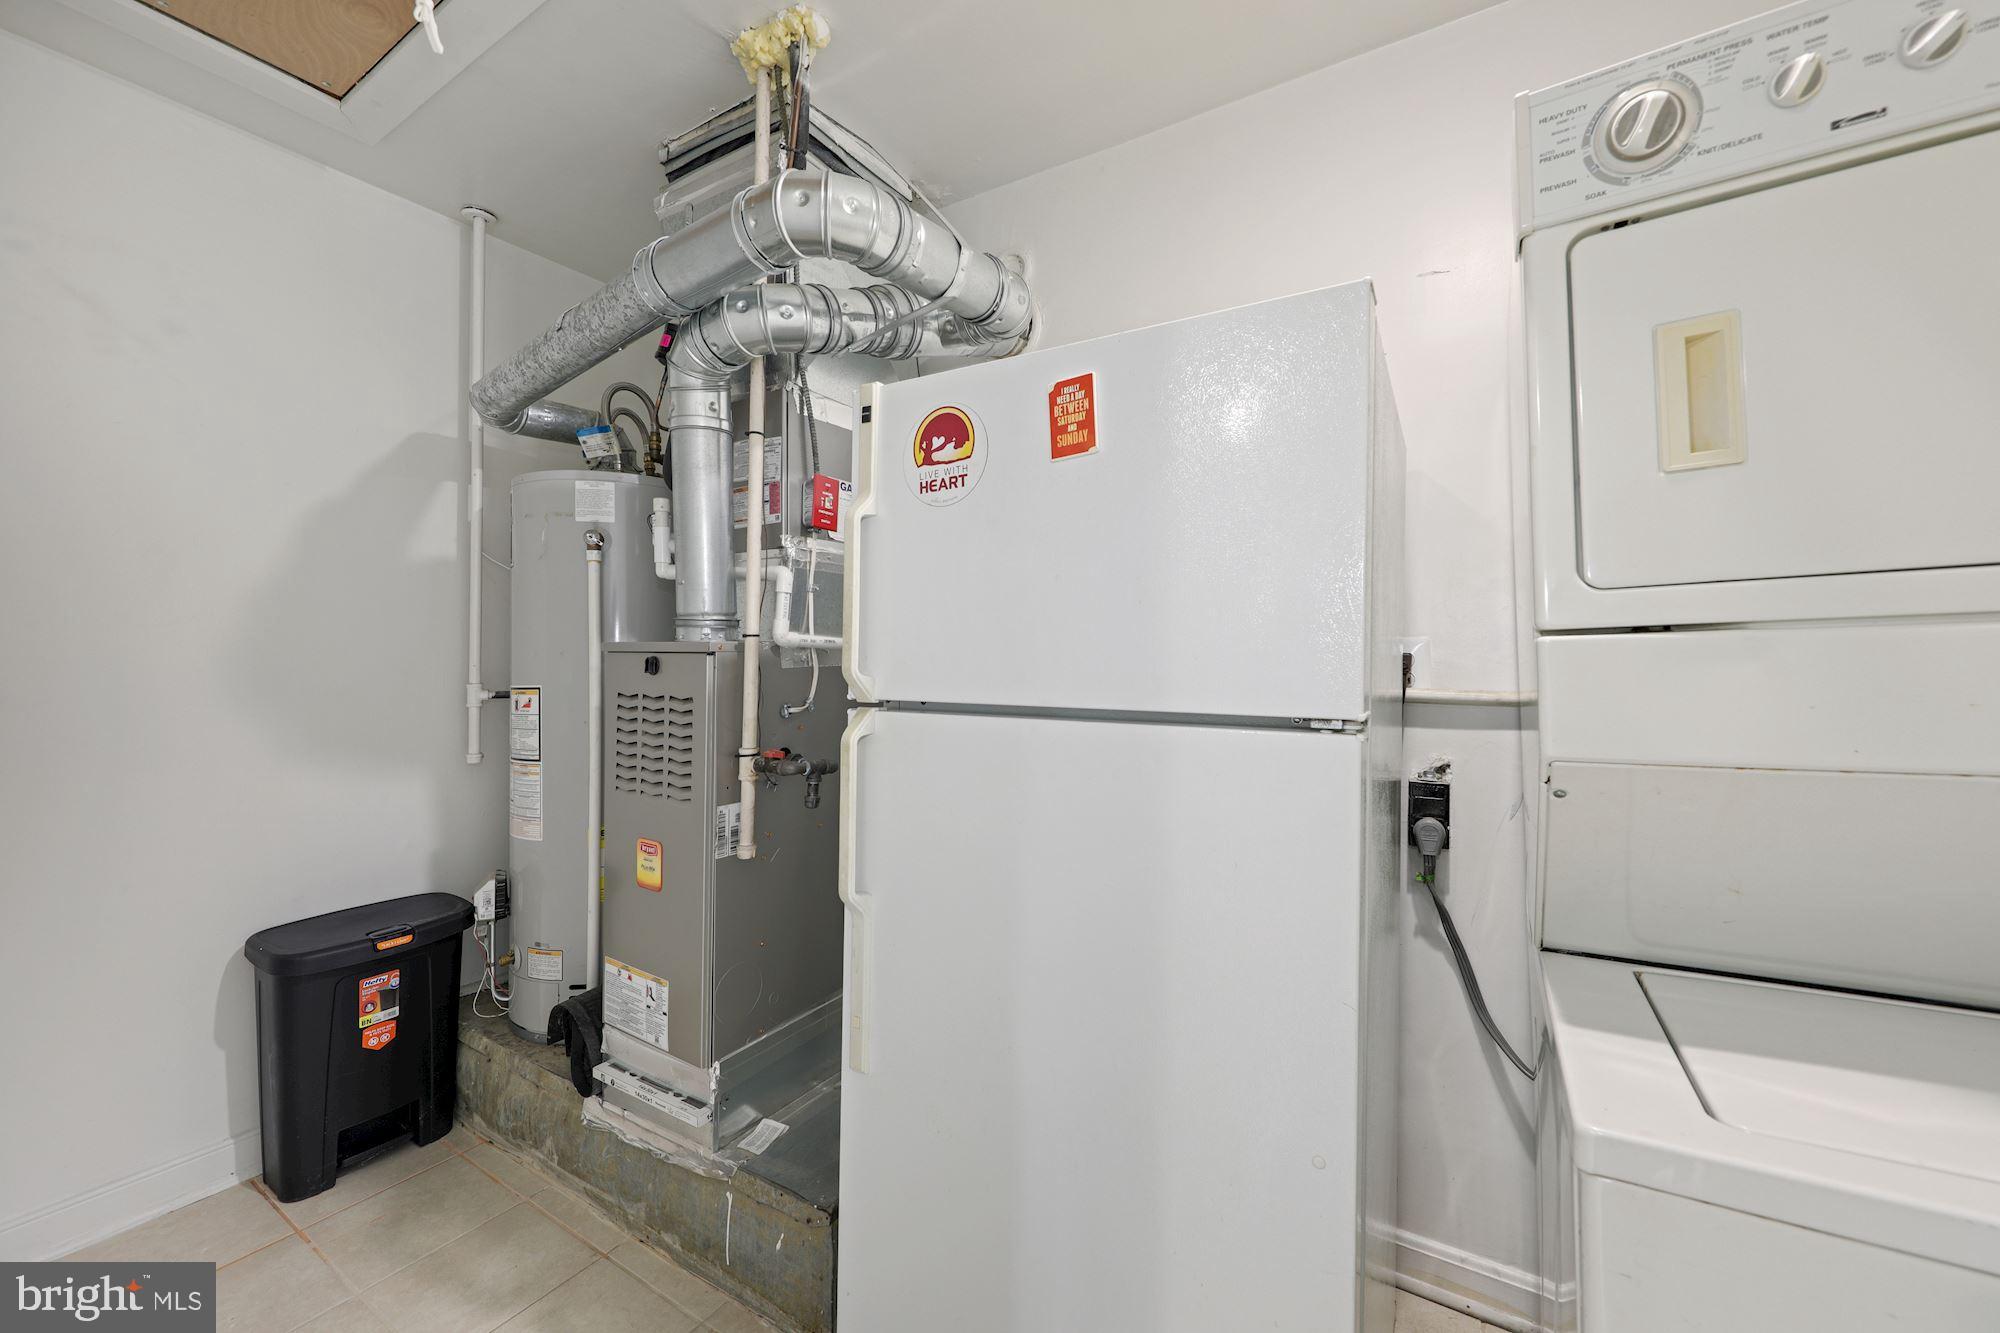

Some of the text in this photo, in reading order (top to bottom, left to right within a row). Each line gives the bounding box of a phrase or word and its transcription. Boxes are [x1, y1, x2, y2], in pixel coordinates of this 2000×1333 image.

[1766, 15, 1830, 41] WATER TEMP
[1666, 48, 1721, 71] PERMANENT
[1723, 37, 1753, 53] PRESS
[1539, 111, 1564, 125] HEAVY
[1566, 104, 1588, 116] DUTY
[1697, 133, 1763, 156] KNIT/DELICATE
[1539, 149, 1576, 164] PREWASH
[1539, 178, 1577, 194] PREWASH
[1585, 190, 1607, 201] SOAK
[1056, 390, 1086, 405] NEED A DAY
[1064, 384, 1080, 394] REALLY
[1054, 397, 1089, 418] BETWEEN
[1057, 411, 1086, 427] SATURDAY
[1067, 423, 1078, 433] AND
[1056, 429, 1088, 448] SUNDAY
[919, 464, 968, 481] LIVE WITH
[919, 473, 968, 494] HEART
